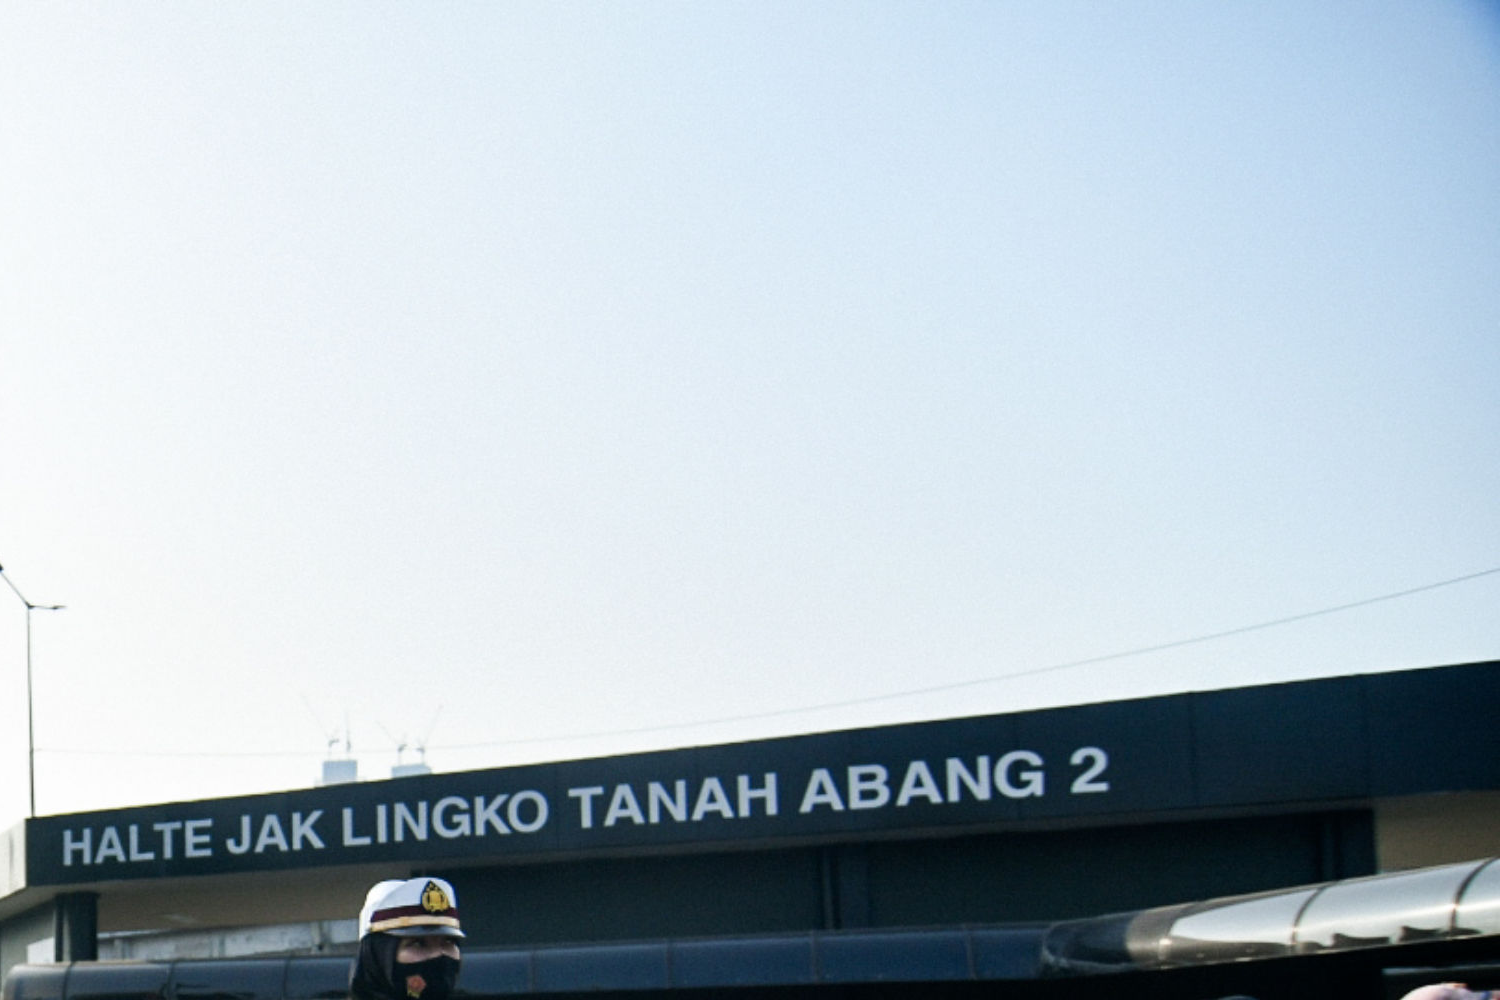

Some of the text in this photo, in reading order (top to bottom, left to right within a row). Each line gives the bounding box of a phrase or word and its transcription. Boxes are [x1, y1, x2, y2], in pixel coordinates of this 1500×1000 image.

[63, 746, 1110, 867] HALTE JAK LINGKO TANAH ABANG 2
